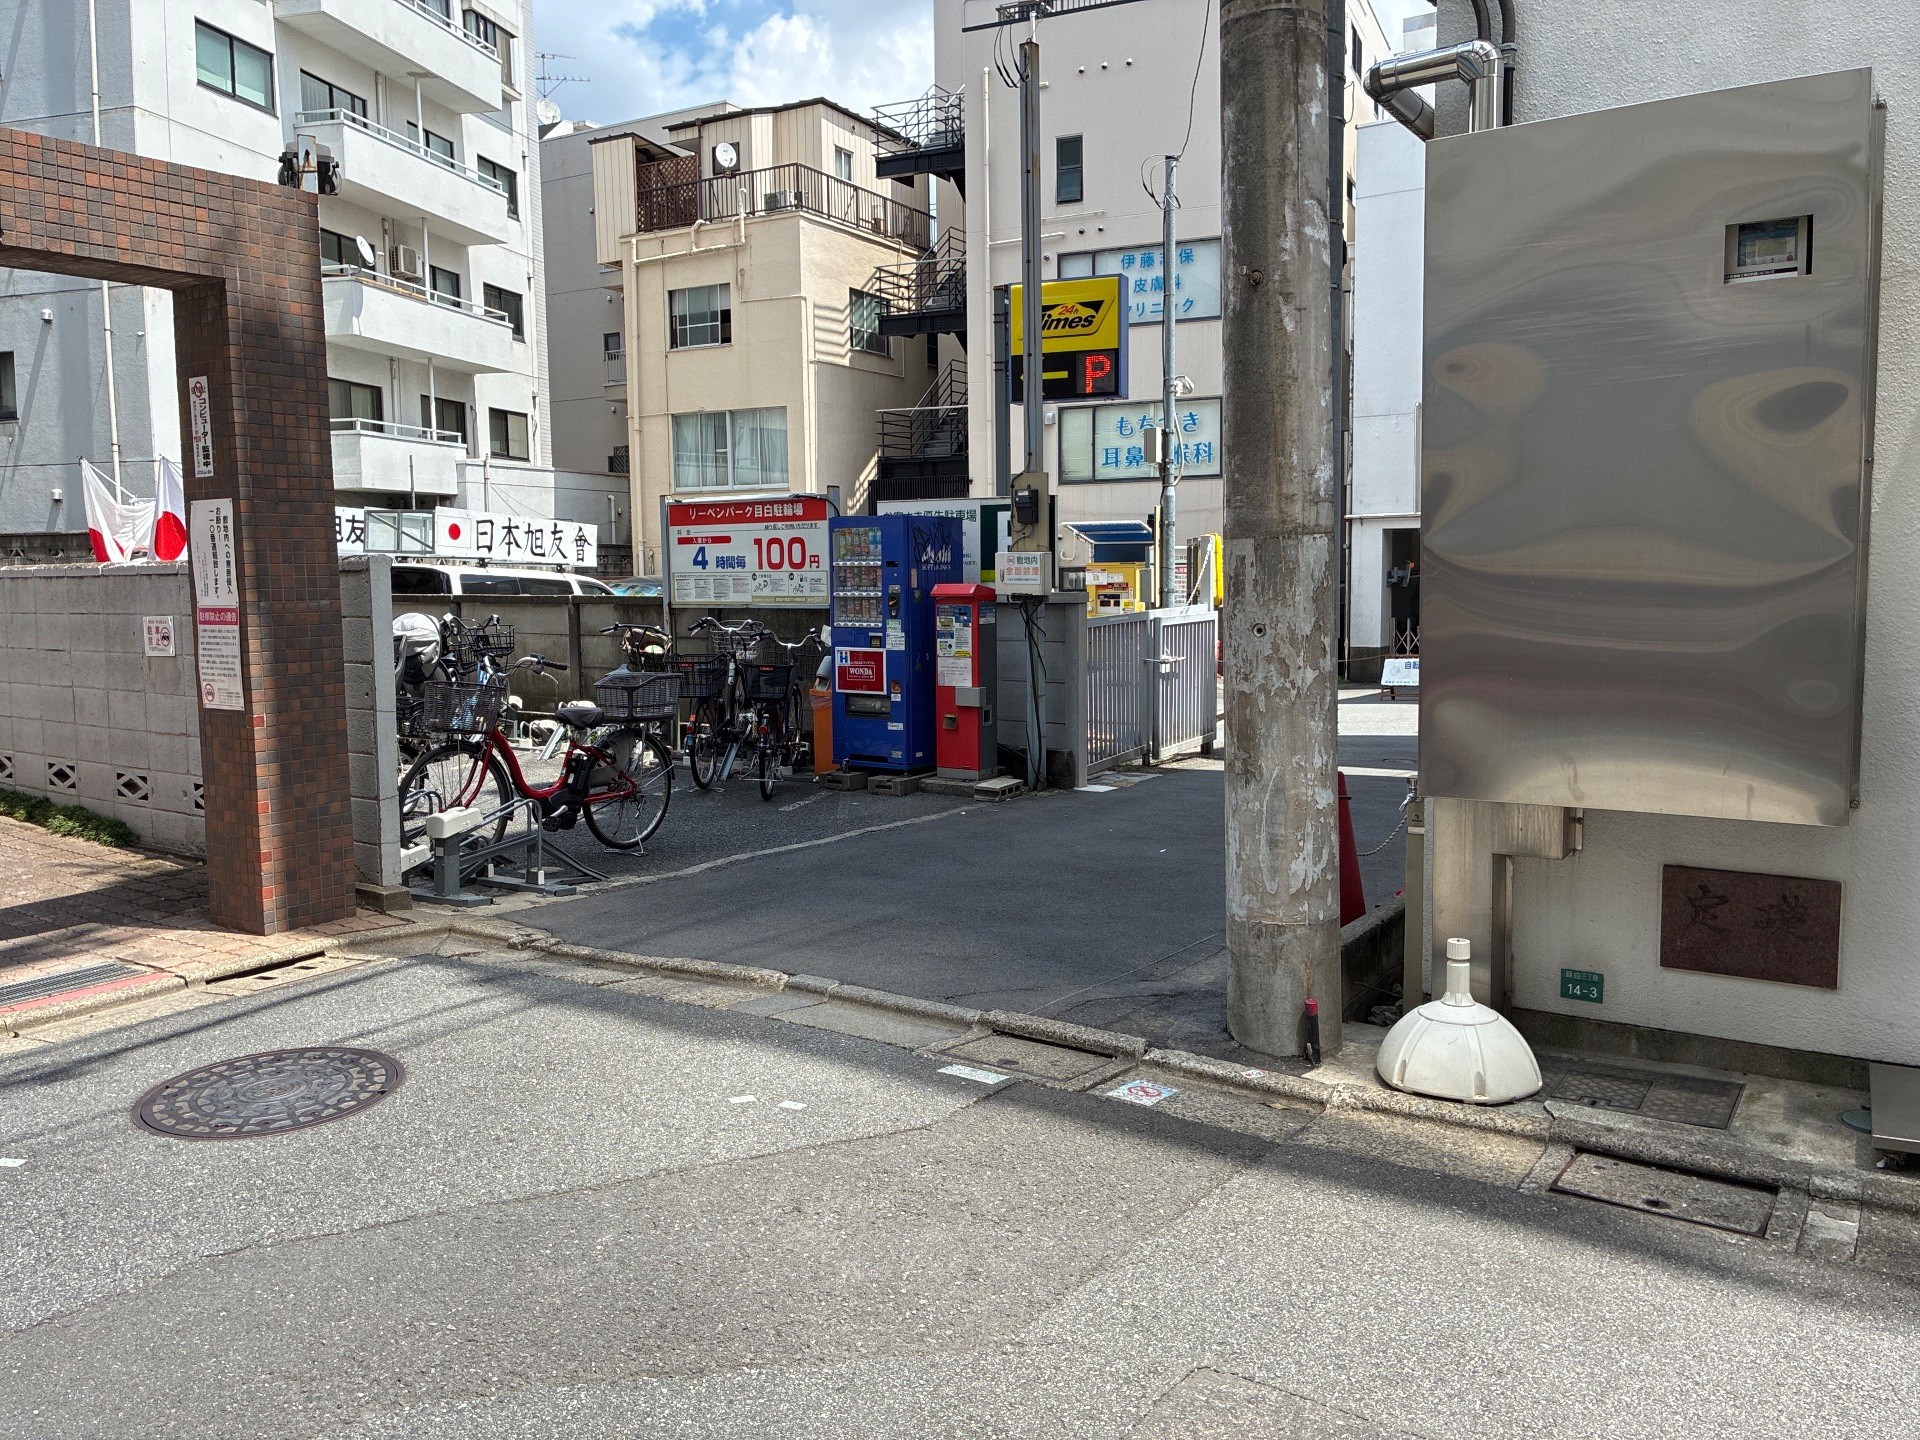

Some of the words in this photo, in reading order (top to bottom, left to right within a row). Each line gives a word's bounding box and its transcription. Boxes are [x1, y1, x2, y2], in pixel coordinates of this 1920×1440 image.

[1120, 248, 1195, 270] 伊藤保
[1128, 298, 1195, 317] リニク
[1085, 355, 1111, 394] P
[1102, 441, 1214, 468] 耳鼻喉科
[689, 502, 804, 520] リーベンパーク目白駐輪場
[476, 517, 593, 563] 日本旭友會
[849, 667, 873, 676] WONDA
[1567, 983, 1598, 998] 14-3
